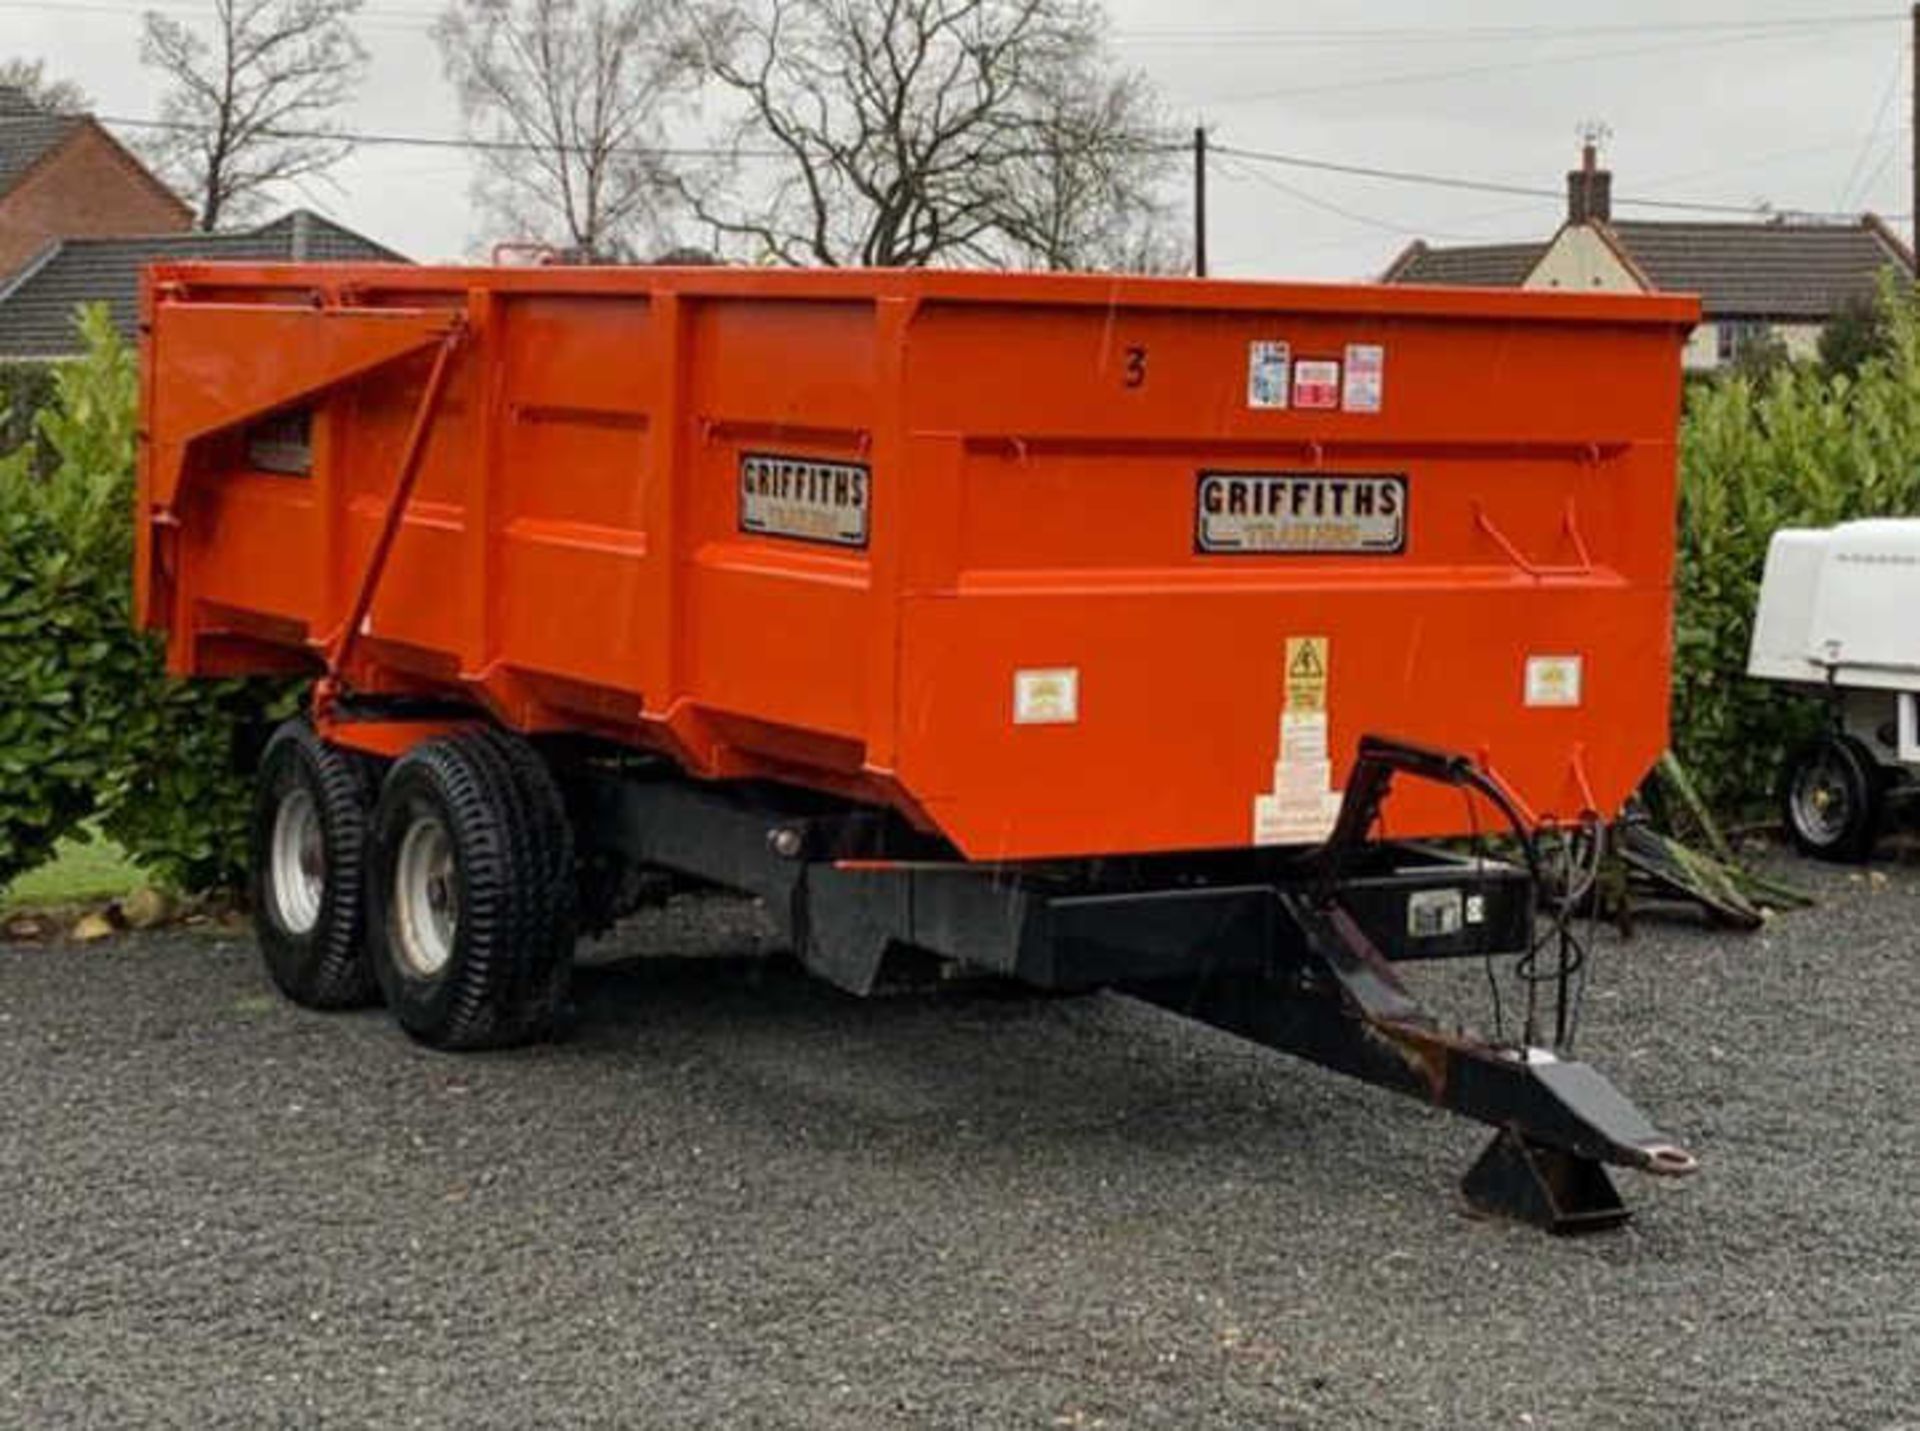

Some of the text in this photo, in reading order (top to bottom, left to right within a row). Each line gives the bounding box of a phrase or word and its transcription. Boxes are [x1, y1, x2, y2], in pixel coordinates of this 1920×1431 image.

[1125, 347, 1147, 387] 3
[744, 461, 864, 507] GRIFFITHS
[1203, 480, 1398, 516] GRIFFITHS
